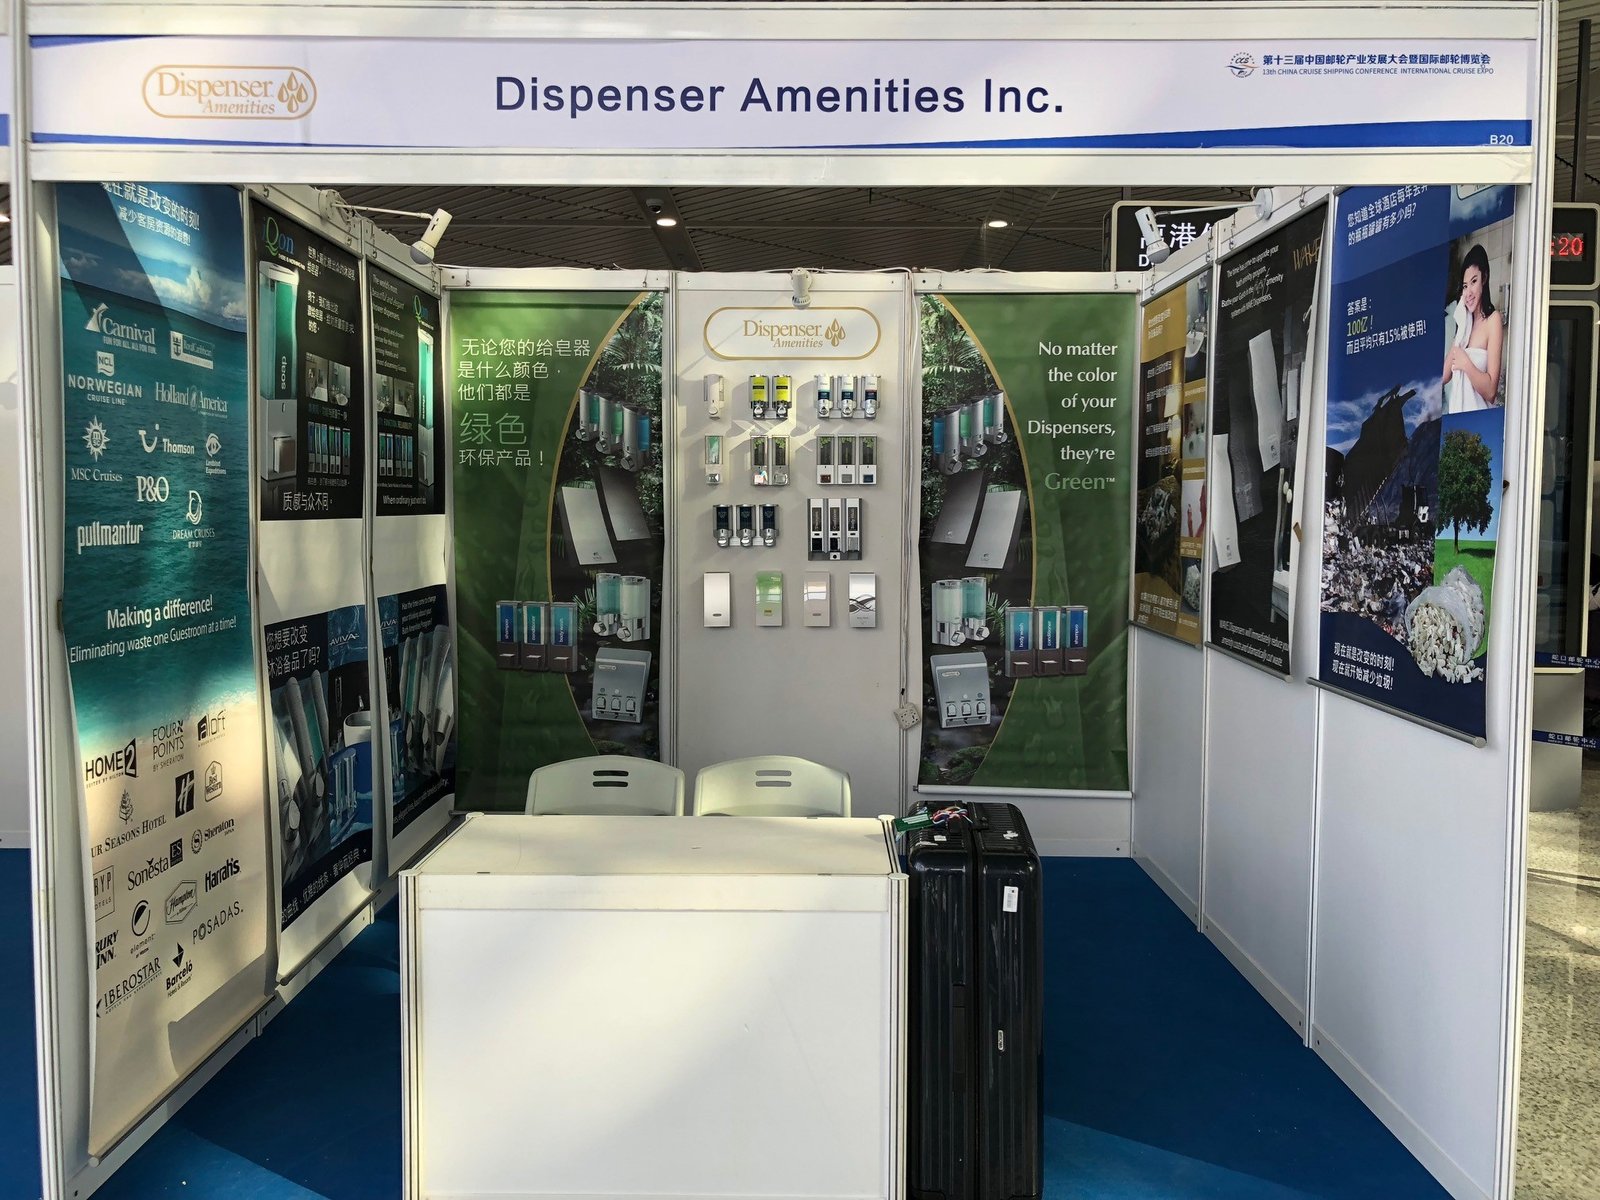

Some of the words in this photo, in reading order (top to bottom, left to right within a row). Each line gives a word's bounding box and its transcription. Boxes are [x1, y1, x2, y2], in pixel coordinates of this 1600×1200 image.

[1263, 53, 1491, 66] 第十三届中国邮轮产业发展大会暨国际邮轮博览会
[1262, 68, 1277, 76] 13th
[1323, 67, 1354, 75] SHIPPING
[1355, 67, 1398, 75] CONFERENCE
[1400, 67, 1451, 75] INTERNATIONAL
[1452, 67, 1475, 75] CRUISE
[1477, 67, 1494, 75] EXPO
[156, 70, 272, 104] Dispenser
[495, 76, 725, 119] Dispenser
[740, 77, 965, 113] Amenities
[984, 78, 1064, 113] Inc.
[202, 98, 276, 116] Amenities
[1489, 134, 1514, 145] B20
[103, 317, 156, 345] Carnival
[743, 319, 823, 342] Dispenser
[461, 338, 591, 358] 无论您的给皂器
[772, 337, 824, 349] Amenities
[1038, 341, 1062, 356] No
[1066, 342, 1118, 356] matter
[98, 355, 114, 367] NCL
[1048, 367, 1073, 382] the
[1077, 366, 1118, 382] color
[67, 373, 142, 398] NORWEGIAN
[458, 383, 532, 402] 他们都是
[87, 393, 111, 404] CRUISE
[112, 396, 126, 406] LINE
[155, 381, 189, 405] Holland
[199, 391, 228, 412] America
[1061, 393, 1079, 408] of
[1081, 397, 1117, 413] your
[459, 411, 527, 446] 绿色
[1028, 420, 1116, 438] Dispensers,
[162, 438, 195, 455] Thomson
[71, 467, 91, 481] MSC
[92, 469, 123, 482] Cruises
[136, 475, 170, 503] P&O
[77, 520, 144, 555] pullmantur
[172, 529, 193, 540] DREAM
[194, 528, 216, 539] CRUISES
[106, 605, 153, 630] Making
[154, 608, 161, 621] a
[162, 594, 213, 620] difference!
[69, 640, 126, 664] Eliminating
[126, 635, 153, 652] waste
[153, 633, 170, 646] one
[169, 623, 208, 643] Guestroom
[208, 622, 215, 633] at
[219, 615, 237, 631] time!
[153, 722, 178, 743] FOUR
[152, 735, 185, 761] POINTS
[160, 754, 185, 770] SHERATON
[104, 826, 140, 852] SEASONS
[142, 815, 167, 835] HOTEL
[204, 818, 235, 842] Sheraton
[127, 856, 169, 891] Sonesta
[130, 933, 156, 954] element
[104, 957, 161, 1008] IBEROSTAR
[165, 959, 193, 990] Barceló
